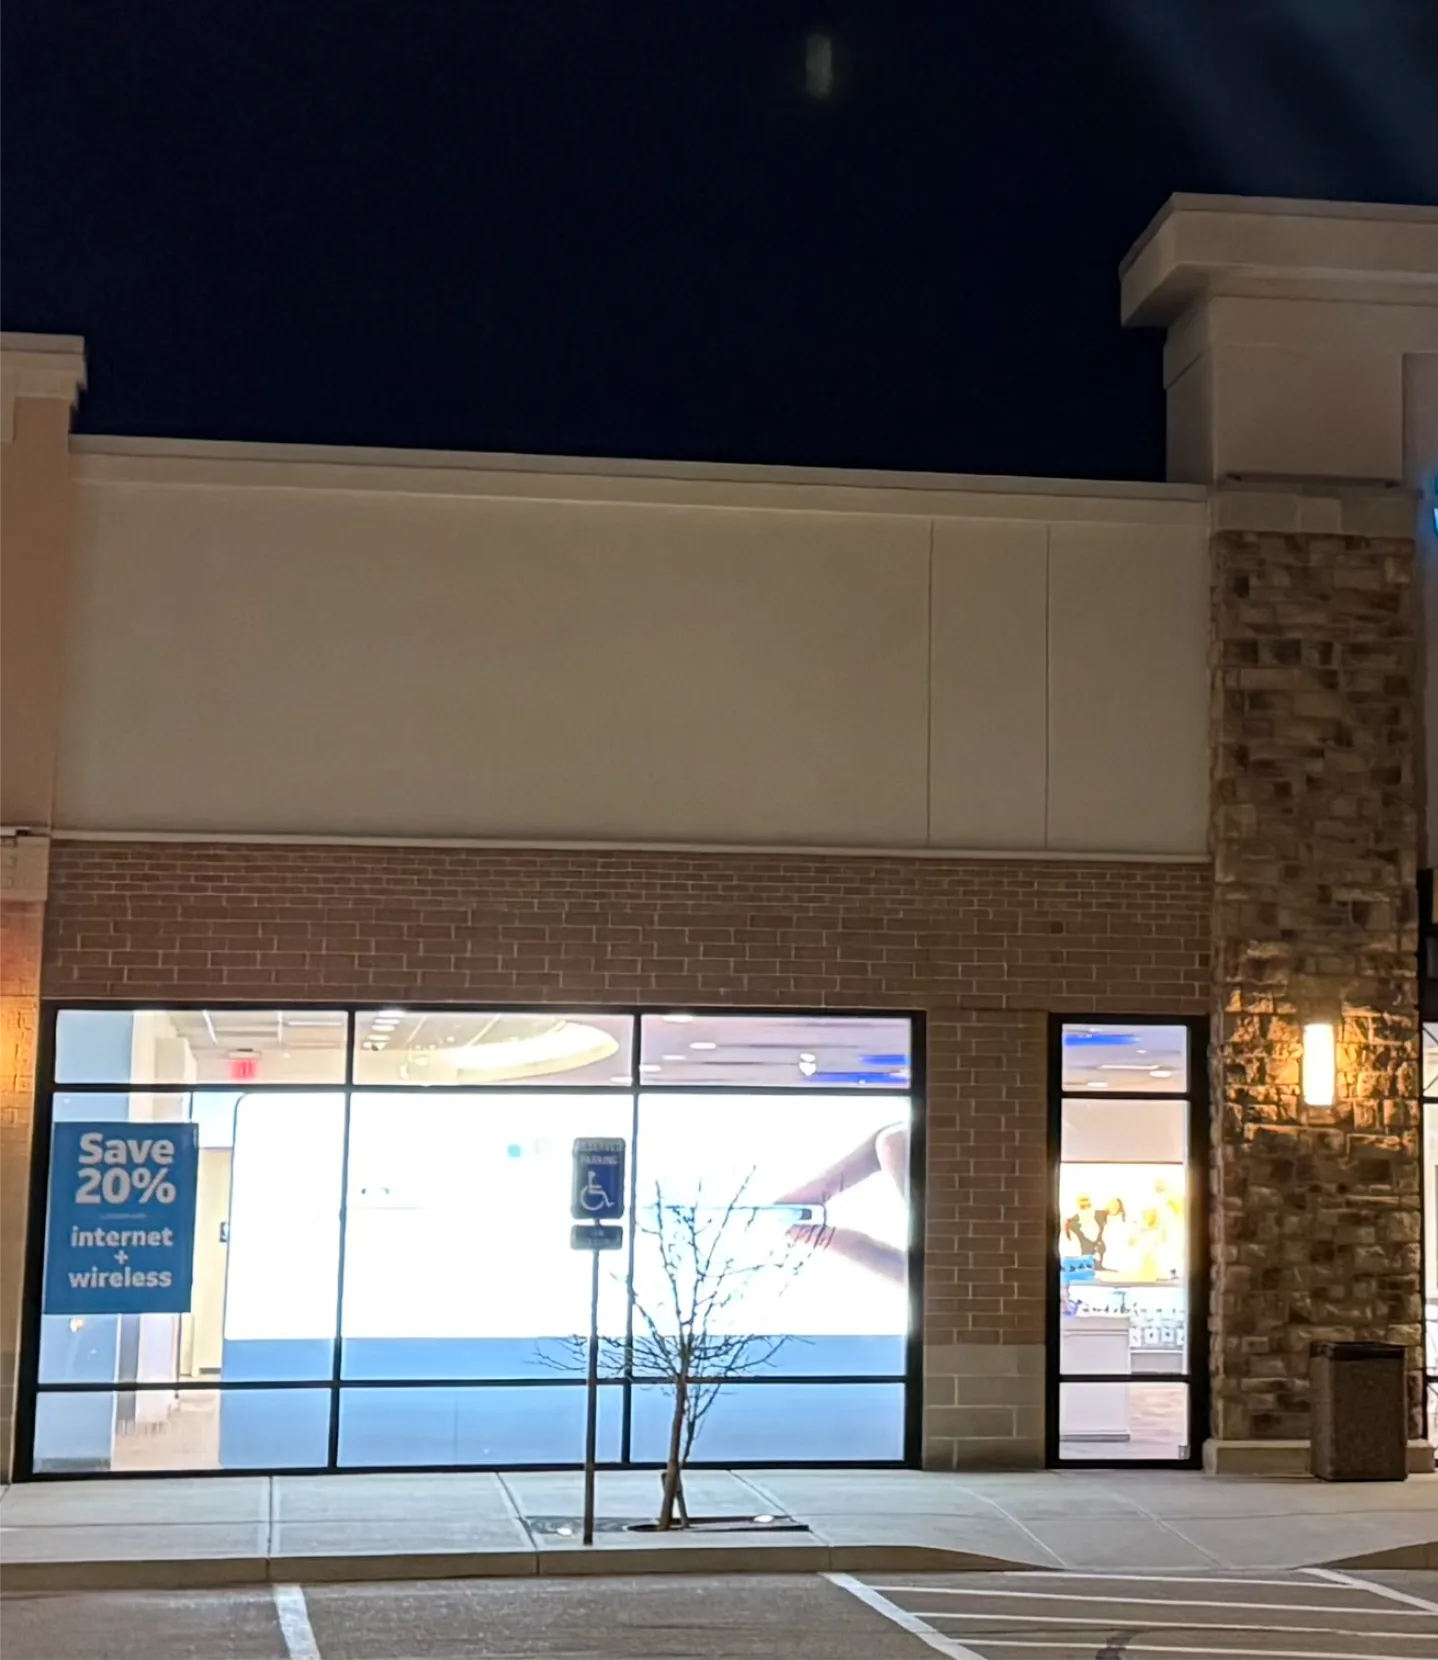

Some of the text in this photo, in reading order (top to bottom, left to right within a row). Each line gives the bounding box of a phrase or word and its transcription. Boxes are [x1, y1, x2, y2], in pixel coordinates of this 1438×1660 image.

[78, 1132, 175, 1165] Save
[75, 1167, 177, 1204] 20%
[71, 1226, 174, 1247] internet
[113, 1250, 129, 1265] +
[68, 1266, 173, 1288] wireless
